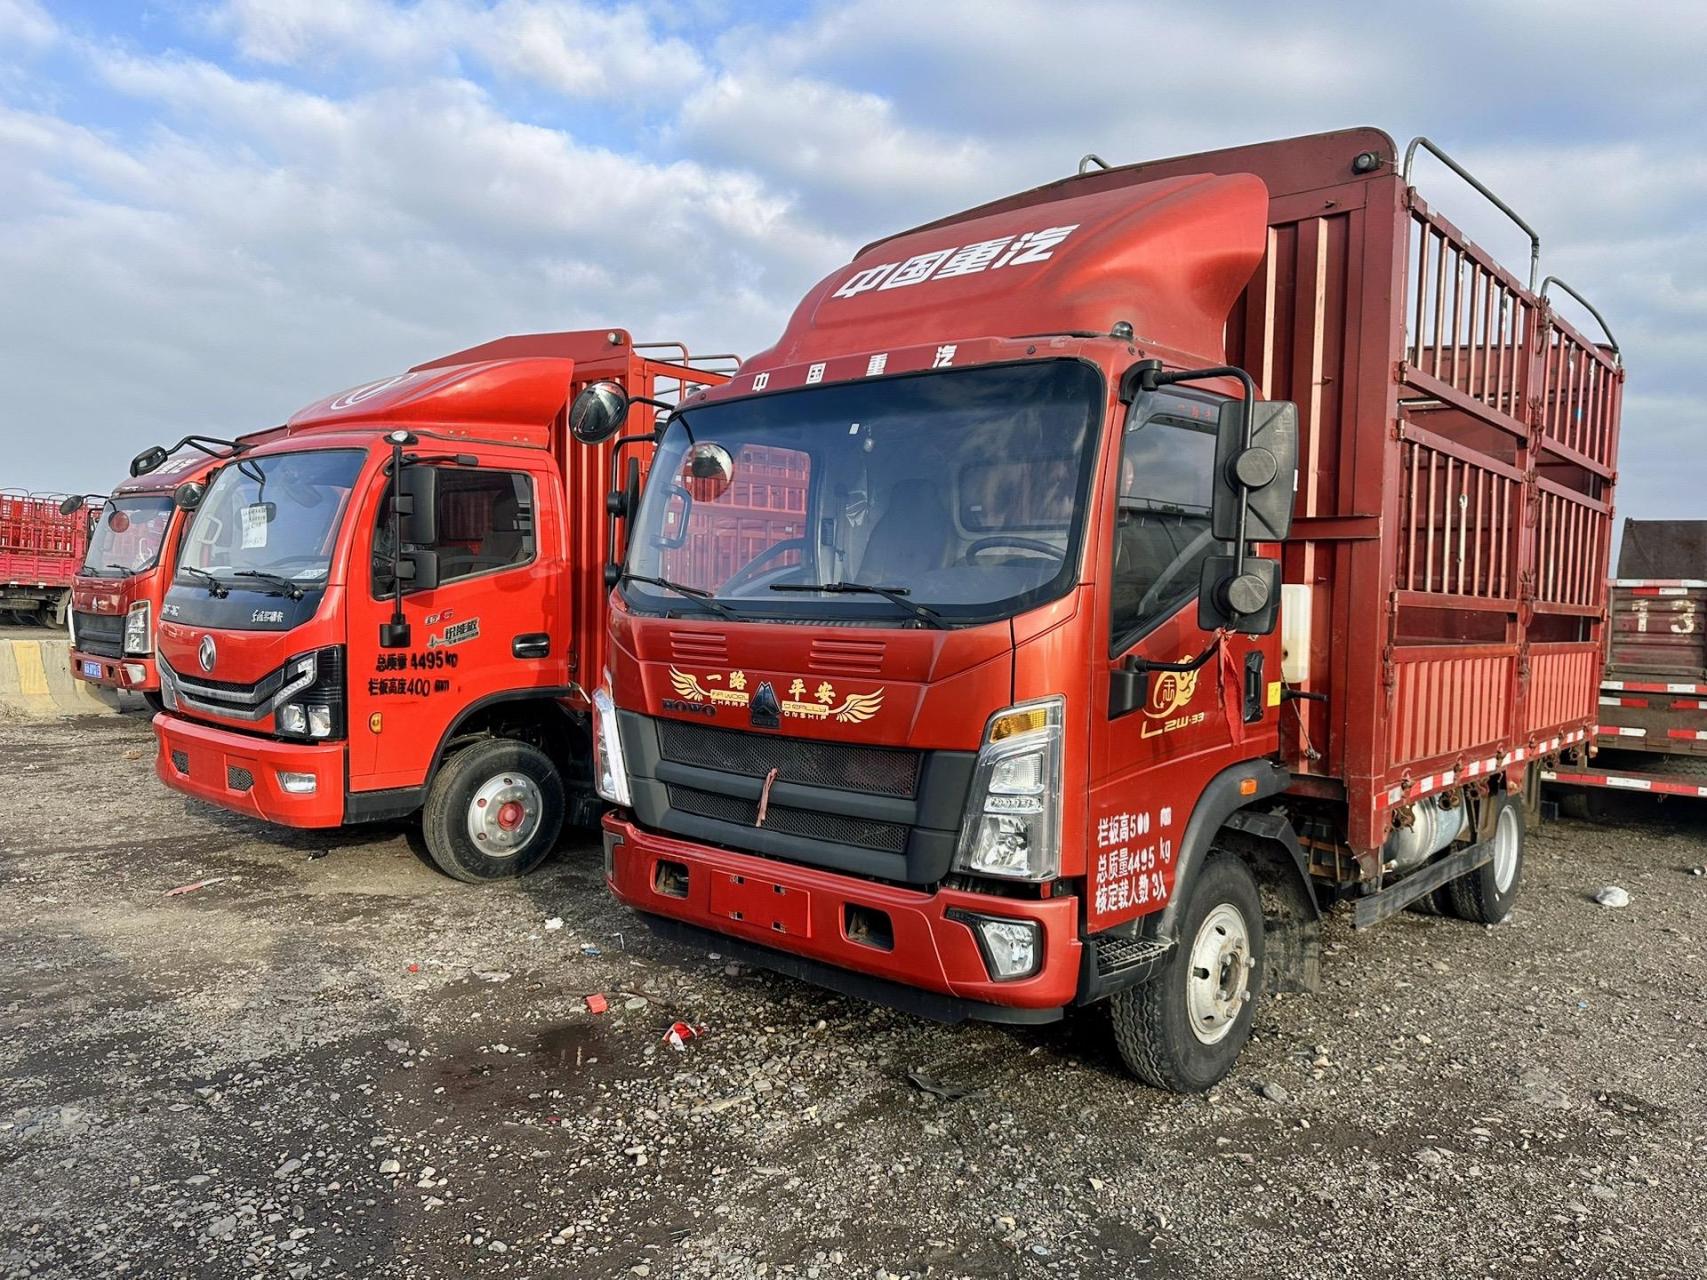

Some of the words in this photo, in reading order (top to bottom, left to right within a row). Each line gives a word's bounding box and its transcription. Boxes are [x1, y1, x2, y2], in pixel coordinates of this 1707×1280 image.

[832, 224, 1080, 299] 中国重汽
[752, 344, 957, 392] 中国重汽
[1632, 600, 1696, 634] 13
[376, 653, 407, 672] 总质量
[411, 651, 443, 670] 4495
[706, 670, 747, 690] 一路
[788, 679, 836, 704] 平安
[662, 698, 717, 717] HOWO
[1160, 837, 1171, 864] kg
[1096, 874, 1149, 915] 核定载人数
